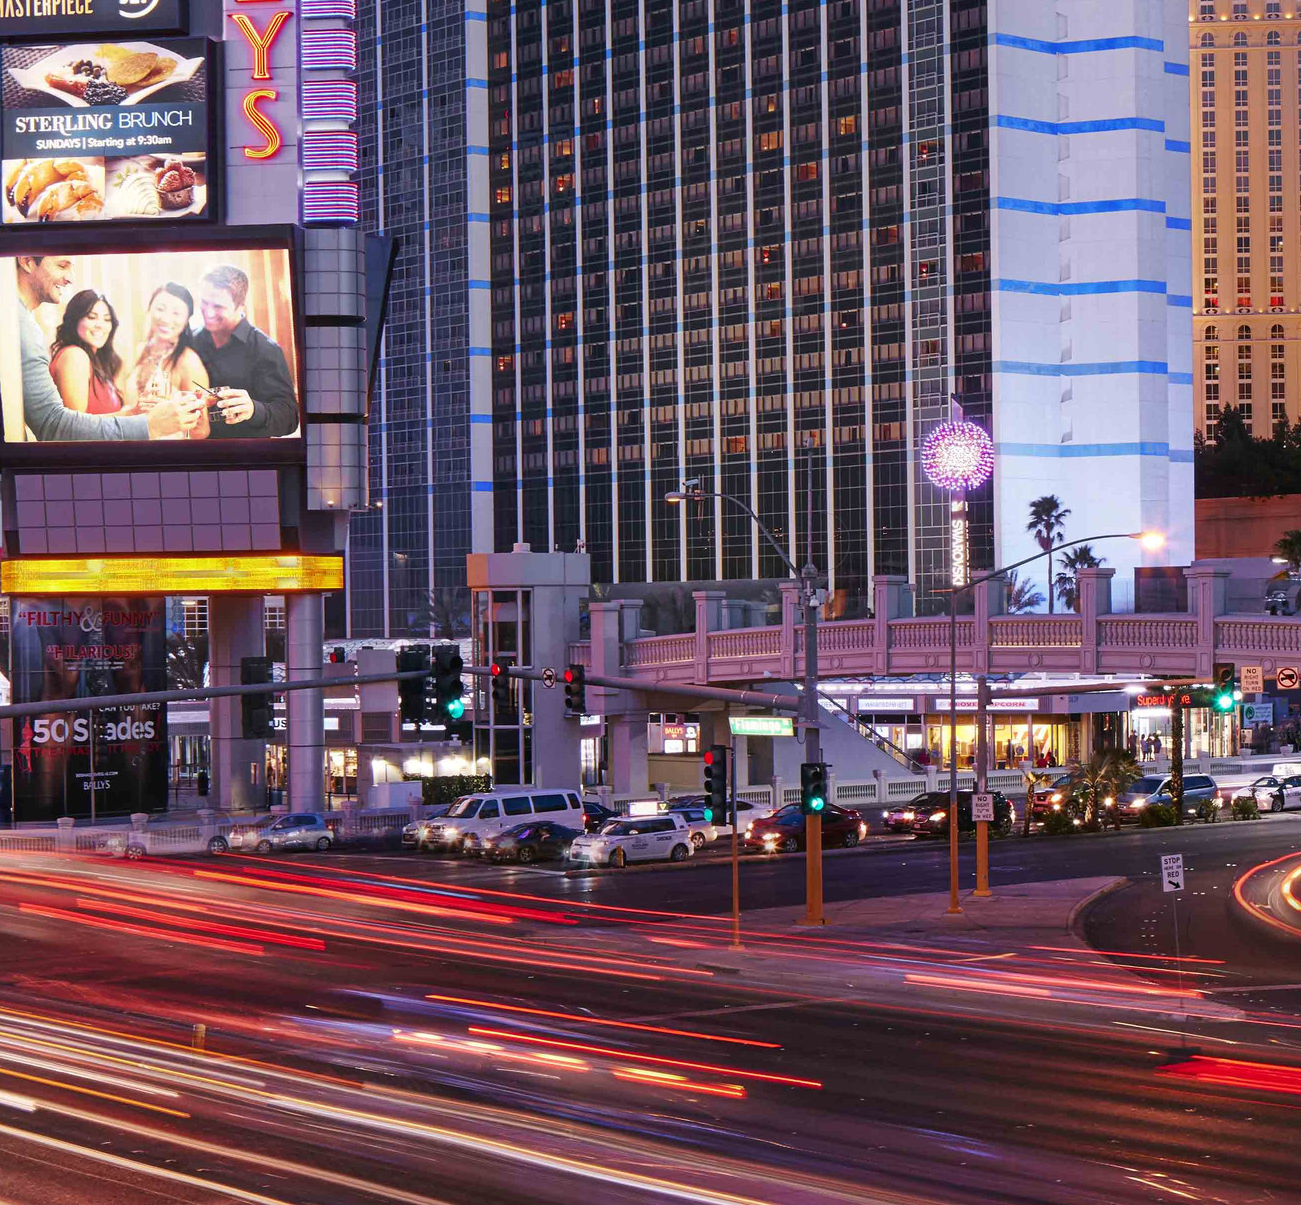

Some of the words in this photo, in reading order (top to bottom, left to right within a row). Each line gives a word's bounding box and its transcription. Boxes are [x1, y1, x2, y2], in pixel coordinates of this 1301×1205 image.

[15, 113, 113, 136] STERLING
[118, 110, 193, 129] BRUNCH
[36, 138, 81, 150] SUNDAYS
[87, 136, 124, 149] Starting
[125, 137, 137, 147] at
[137, 135, 172, 146] 9:30am
[952, 519, 964, 586] SWAROVSKI
[140, 702, 161, 711] AKE?
[33, 718, 69, 744] 50
[1164, 857, 1181, 865] STOP
